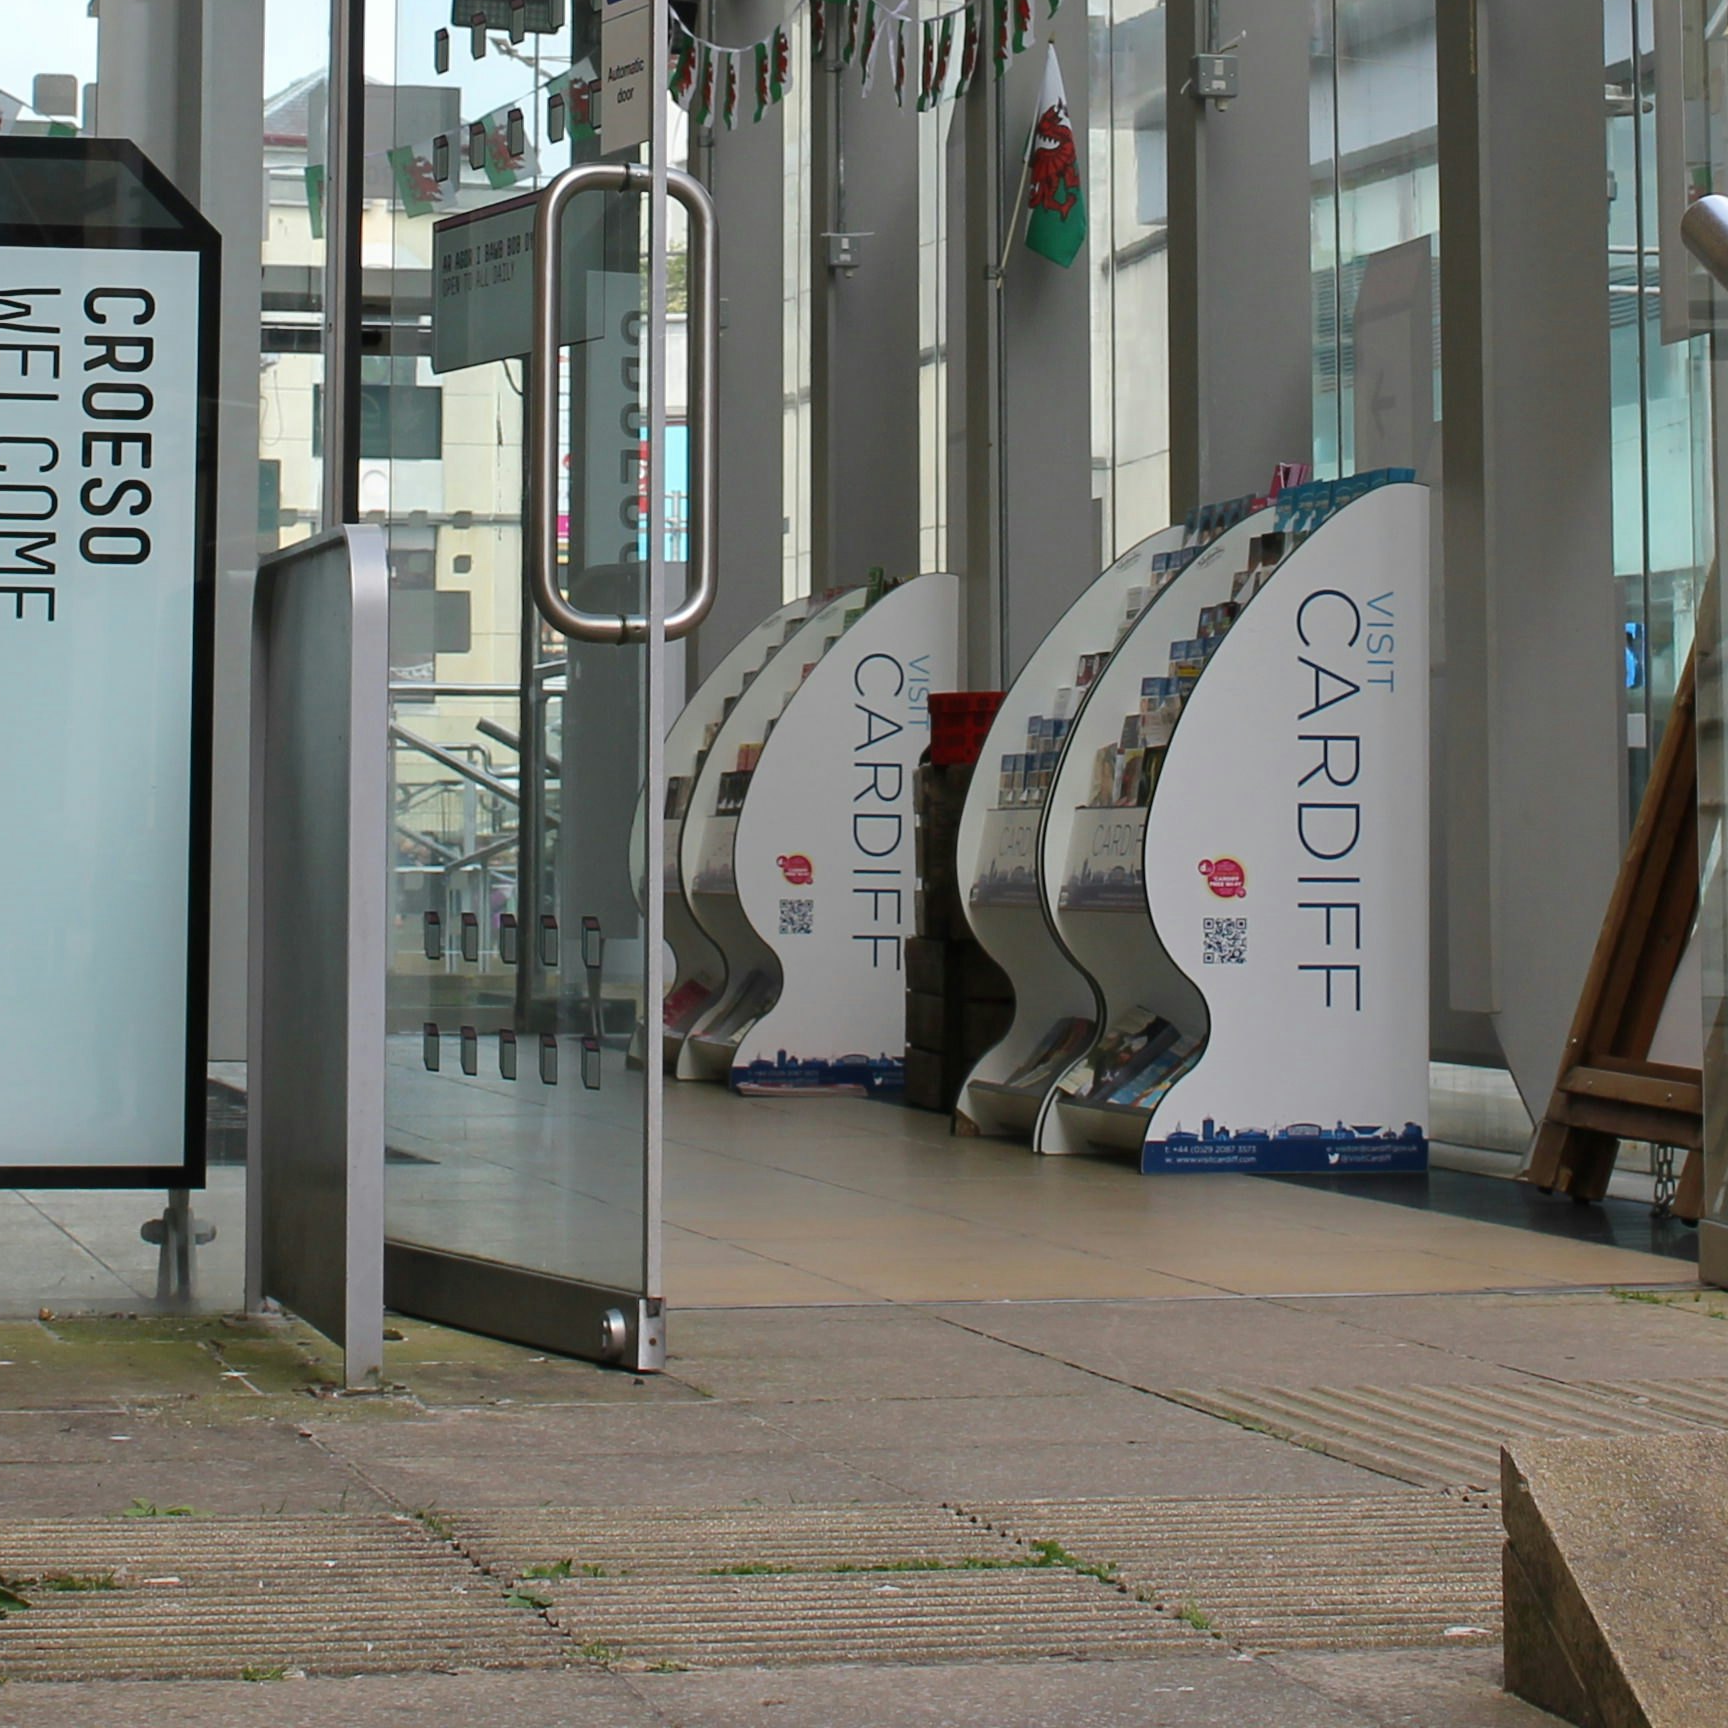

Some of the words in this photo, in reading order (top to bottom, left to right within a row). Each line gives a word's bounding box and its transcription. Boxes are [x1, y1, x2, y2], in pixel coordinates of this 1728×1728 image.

[607, 57, 645, 83] Automatic
[616, 86, 635, 104] door
[79, 287, 156, 565] CROESO
[907, 654, 931, 731] VISIT
[1365, 590, 1395, 694] VISIT
[851, 652, 905, 972] CARDIFF
[1297, 589, 1361, 1012] CARDIFF
